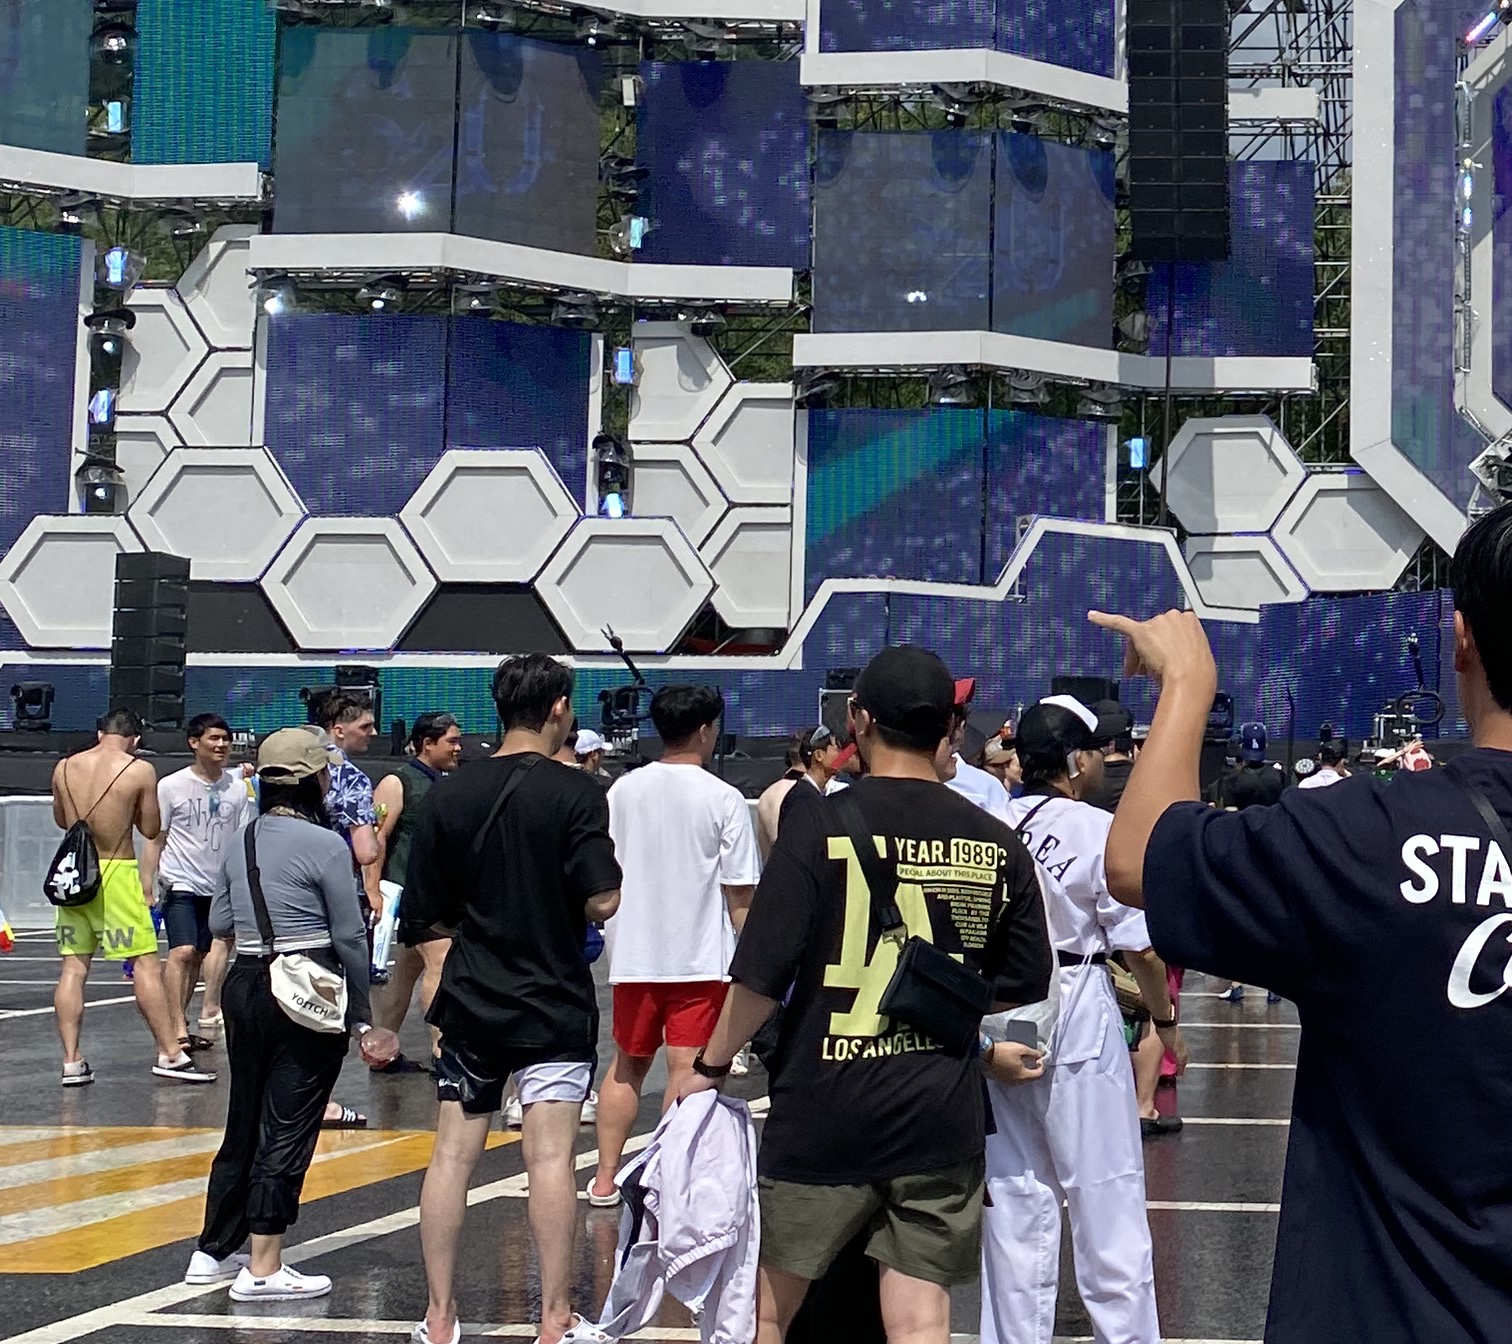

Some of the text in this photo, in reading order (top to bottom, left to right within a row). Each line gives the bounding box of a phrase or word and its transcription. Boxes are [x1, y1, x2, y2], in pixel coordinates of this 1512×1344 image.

[952, 840, 996, 868] 1989
[926, 868, 953, 877] ABOUT
[822, 1036, 863, 1062] LOS
